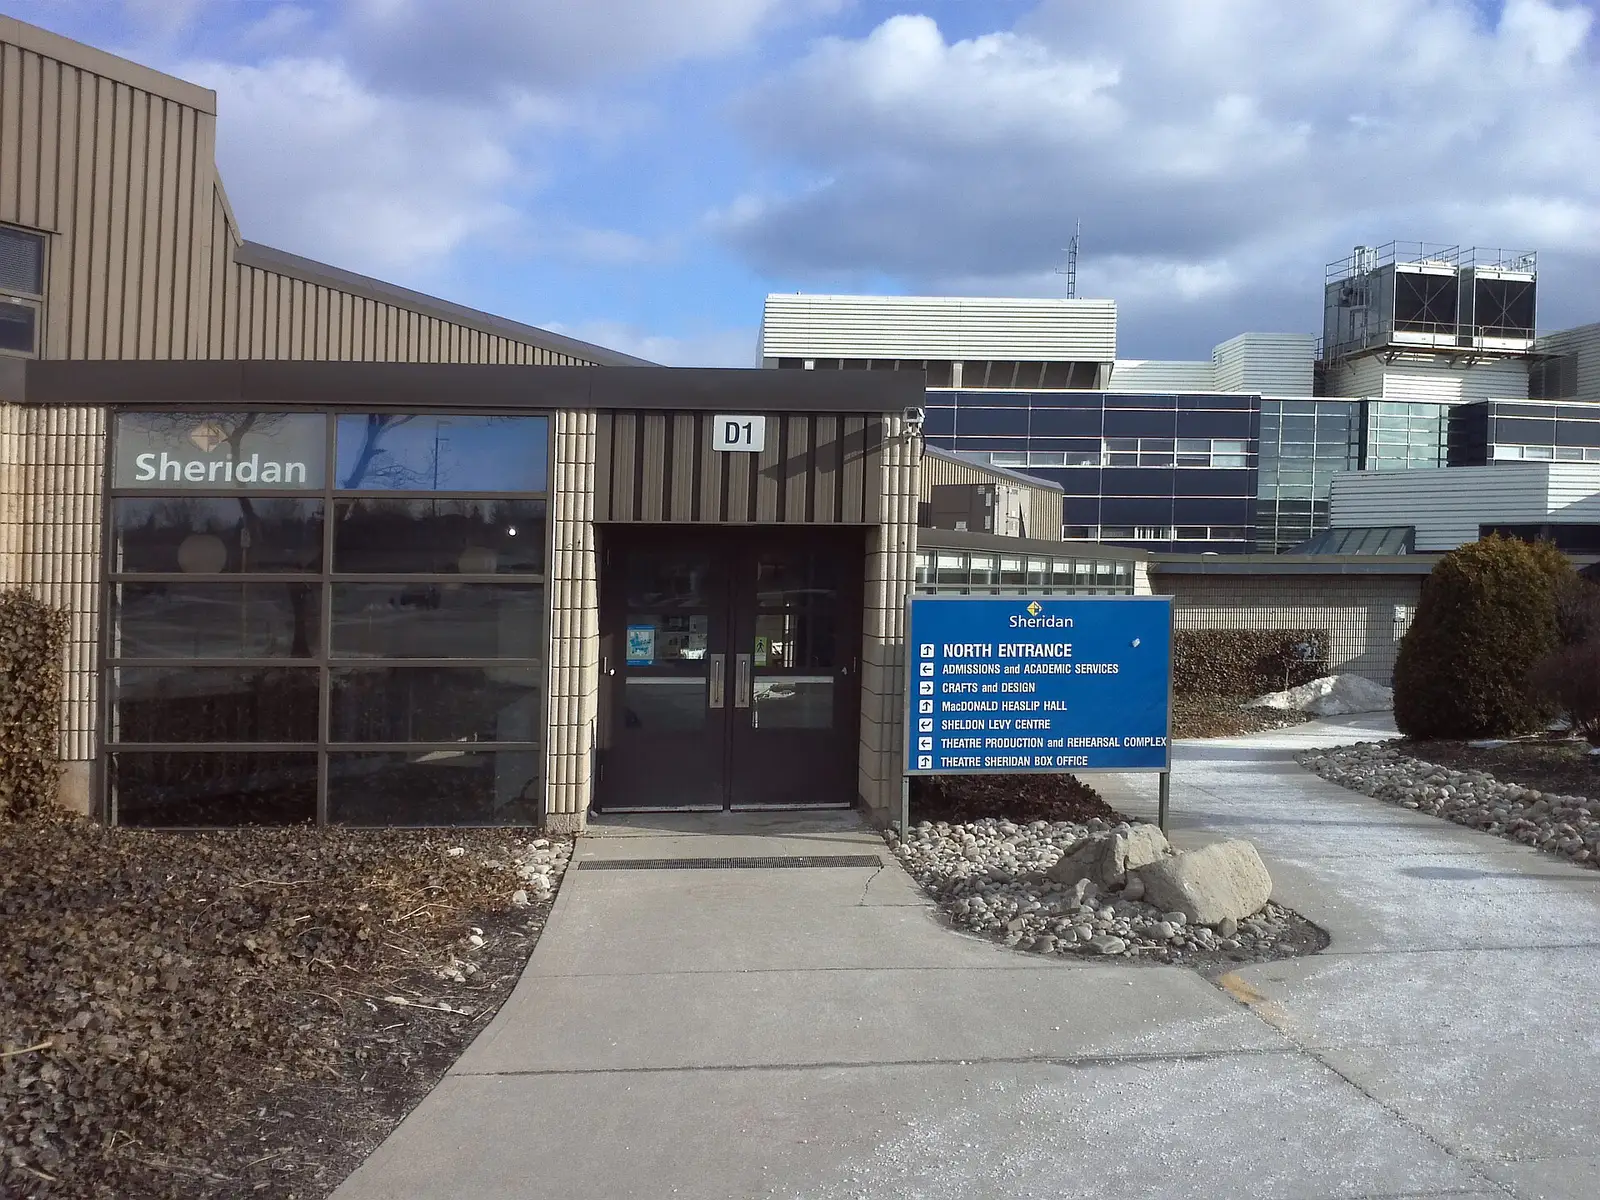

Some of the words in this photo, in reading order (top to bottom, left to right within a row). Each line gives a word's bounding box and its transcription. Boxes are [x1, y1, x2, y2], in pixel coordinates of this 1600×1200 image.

[725, 421, 752, 445] D1
[134, 452, 307, 483] Sheridan
[1009, 615, 1073, 628] Sheridan
[943, 643, 992, 658] NORTH
[998, 643, 1073, 658] ENTRANCE
[942, 663, 1001, 675] ADMISSIONS
[1003, 663, 1020, 674] and
[1023, 663, 1072, 674] ACADEMIC
[1074, 663, 1119, 674] SERVICES
[942, 682, 978, 693] CRAFTS
[981, 682, 998, 693] and
[1001, 682, 1036, 693] DESIGN
[941, 701, 999, 712] MacDONALD
[1001, 701, 1041, 712] HEASLIP
[1043, 701, 1068, 711] HALL
[941, 719, 985, 730] SHELDON
[988, 719, 1012, 730] LEVY
[1015, 719, 1051, 730] CENTRE
[940, 738, 982, 749] THEATRE
[985, 738, 1044, 749] PRODUCTION
[1047, 738, 1064, 748] and
[1066, 737, 1121, 748] REHEARSAL
[1123, 736, 1167, 747] COMPLEX
[940, 756, 981, 767] THEATRE
[984, 756, 1031, 767] SHERIDAN
[1034, 756, 1053, 766] BOX
[1056, 756, 1089, 766] OFFICE
